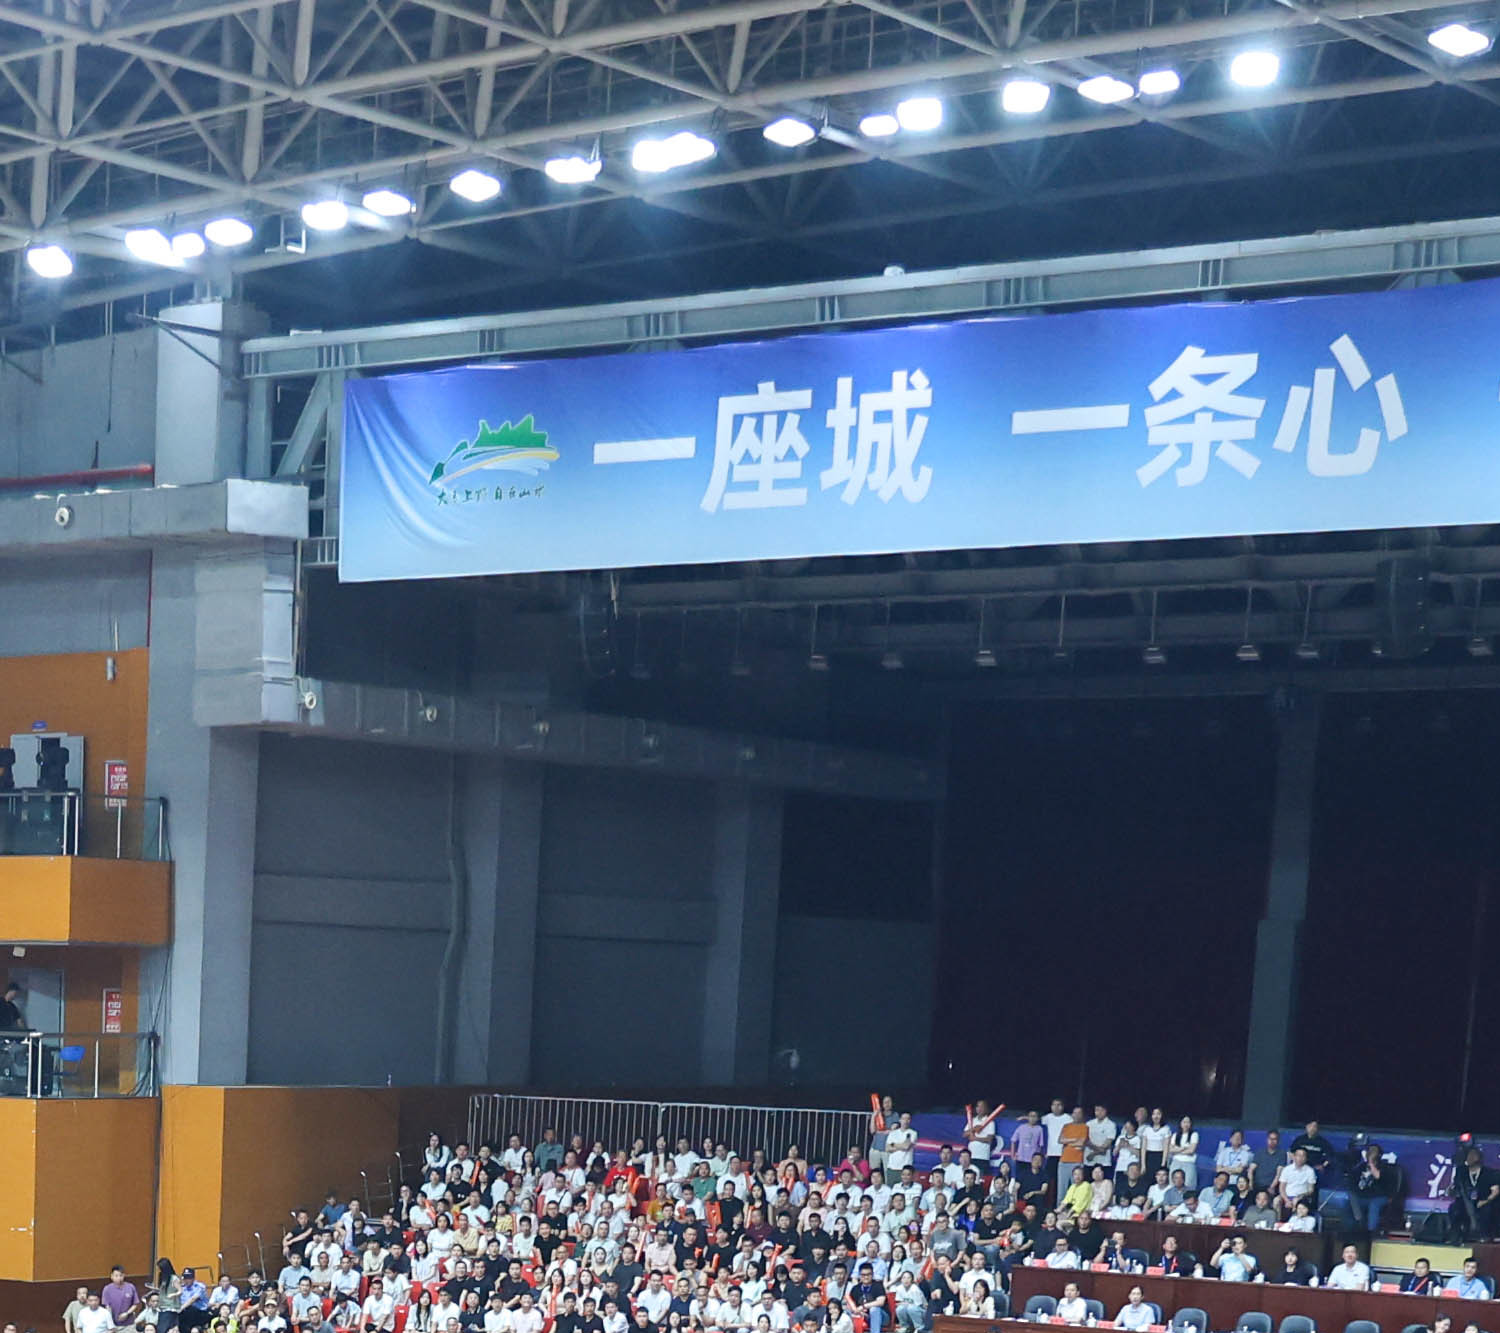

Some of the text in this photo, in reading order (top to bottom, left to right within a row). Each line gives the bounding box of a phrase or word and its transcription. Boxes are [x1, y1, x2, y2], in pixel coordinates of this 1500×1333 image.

[593, 369, 934, 513] 一座城
[1011, 334, 1408, 486] 一条心
